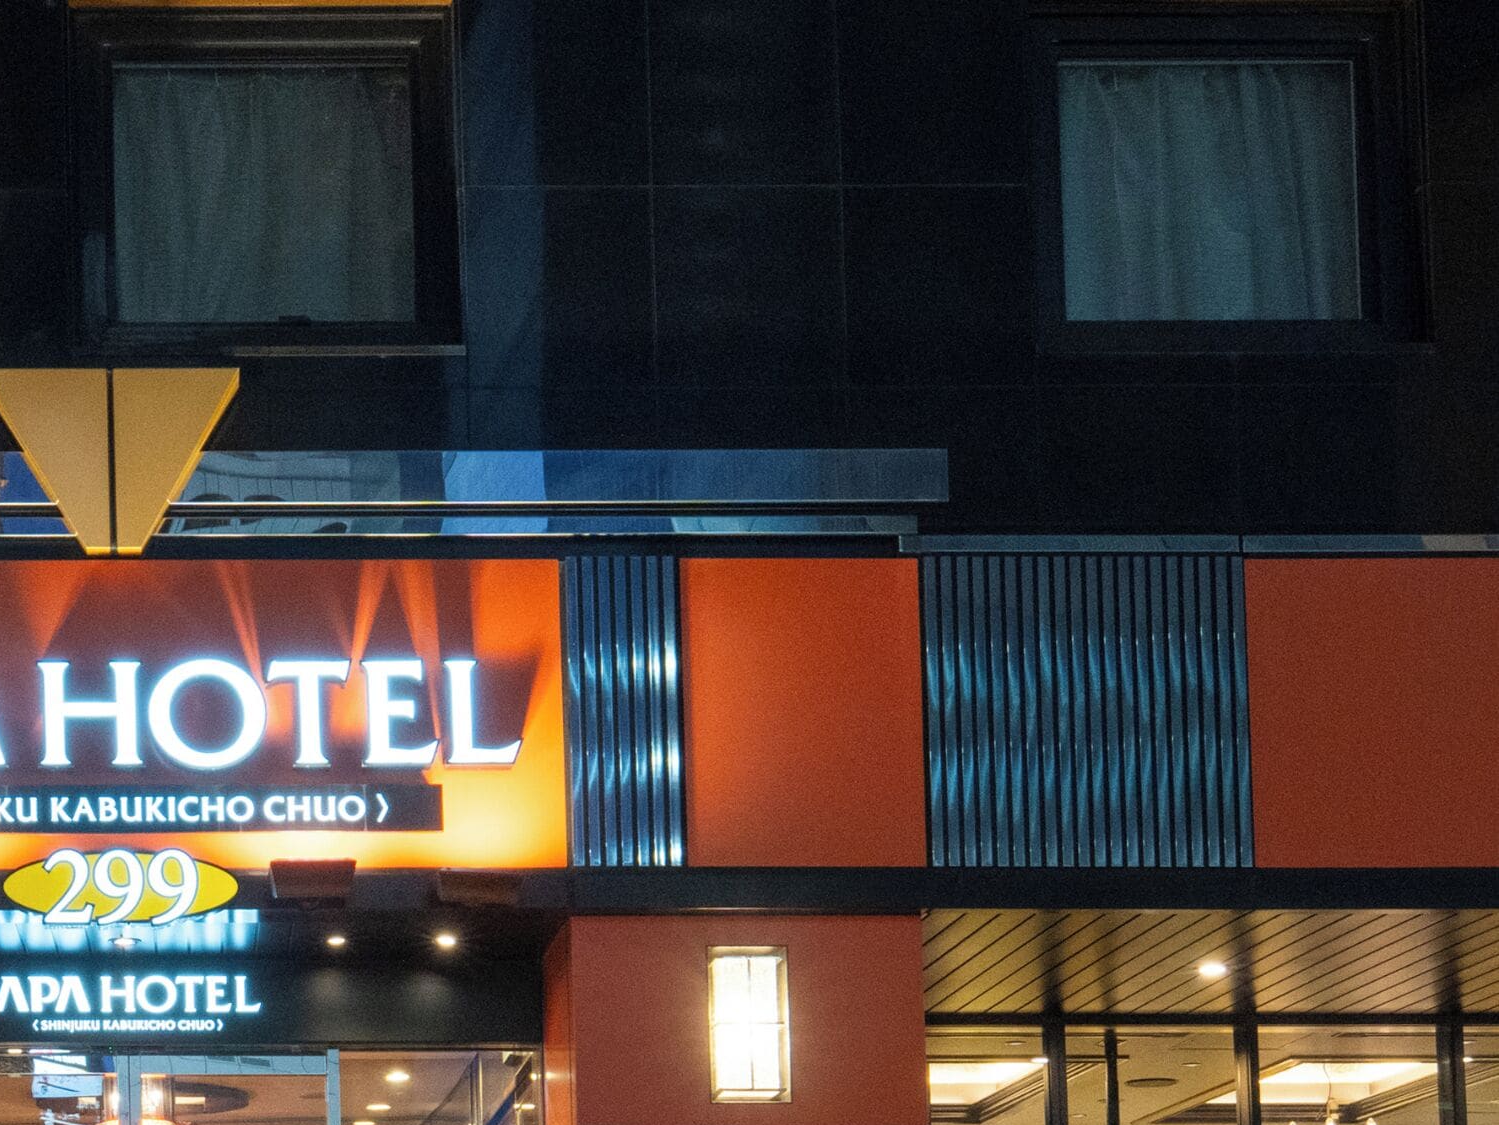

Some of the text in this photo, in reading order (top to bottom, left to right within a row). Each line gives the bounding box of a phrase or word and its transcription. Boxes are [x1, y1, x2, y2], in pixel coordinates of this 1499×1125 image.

[37, 658, 523, 770] HOTEL
[49, 794, 255, 824] KABUKICHO
[262, 794, 367, 824] CHUO
[41, 847, 200, 927] 299
[99, 974, 262, 1013] HOTEL
[40, 1019, 216, 1033] SHINJUKU KABUKICHO CHUO
